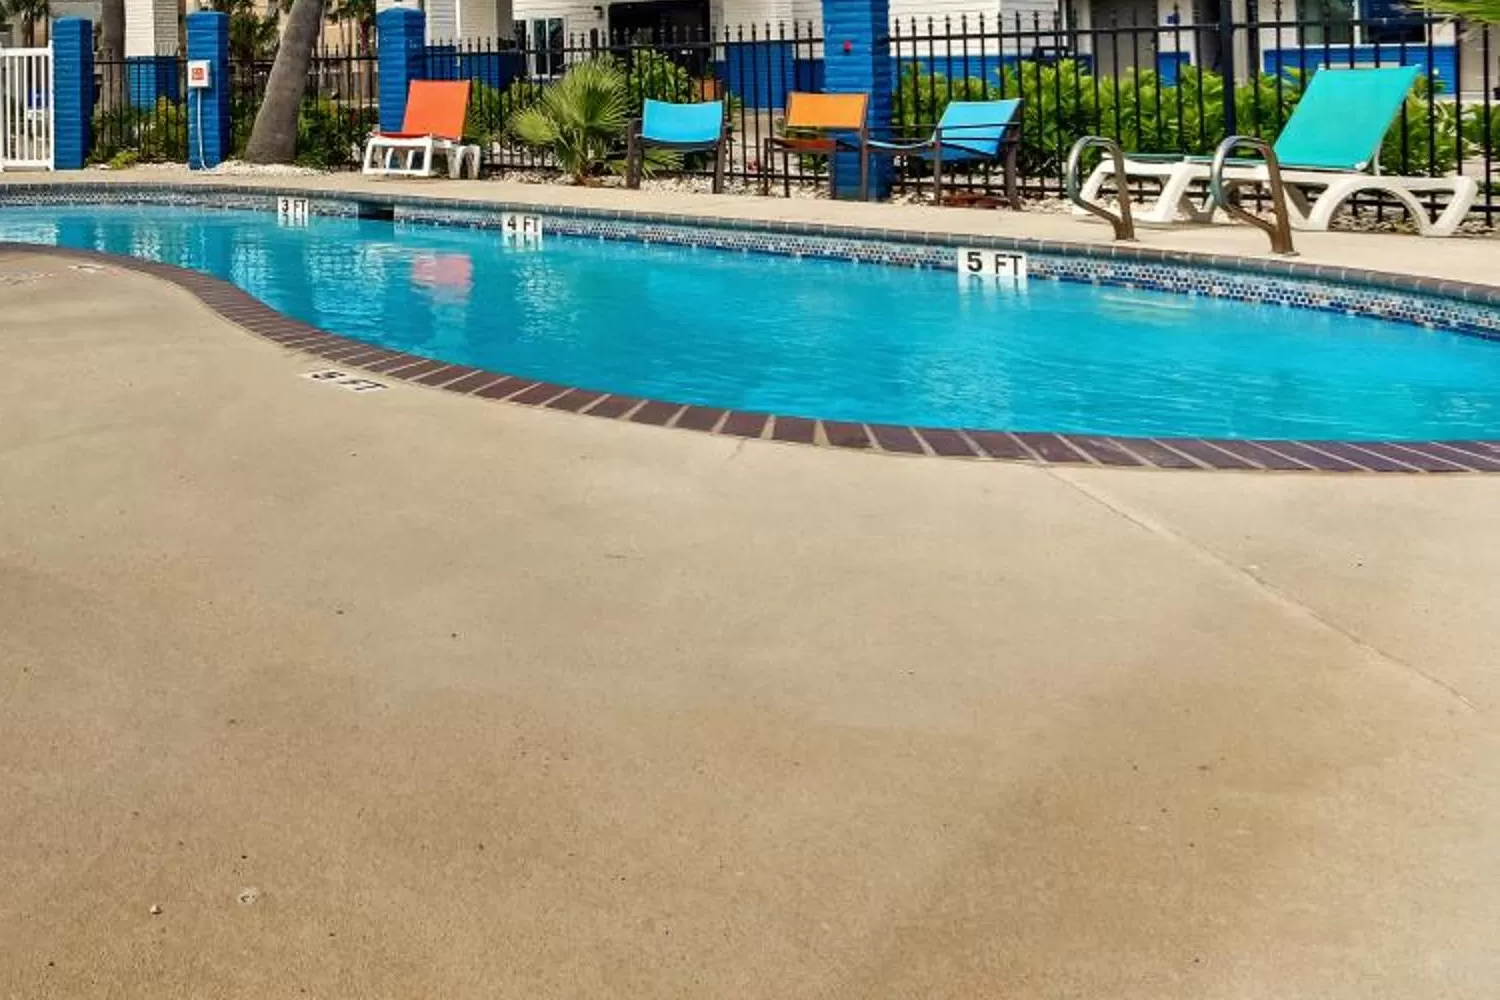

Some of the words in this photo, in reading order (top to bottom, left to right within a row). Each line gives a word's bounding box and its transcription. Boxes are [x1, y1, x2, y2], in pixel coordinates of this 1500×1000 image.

[281, 199, 289, 213] 3
[293, 199, 307, 213] FT
[507, 215, 517, 231] 4
[523, 215, 540, 233] FT
[967, 251, 983, 273] 5
[995, 253, 1023, 276] FT
